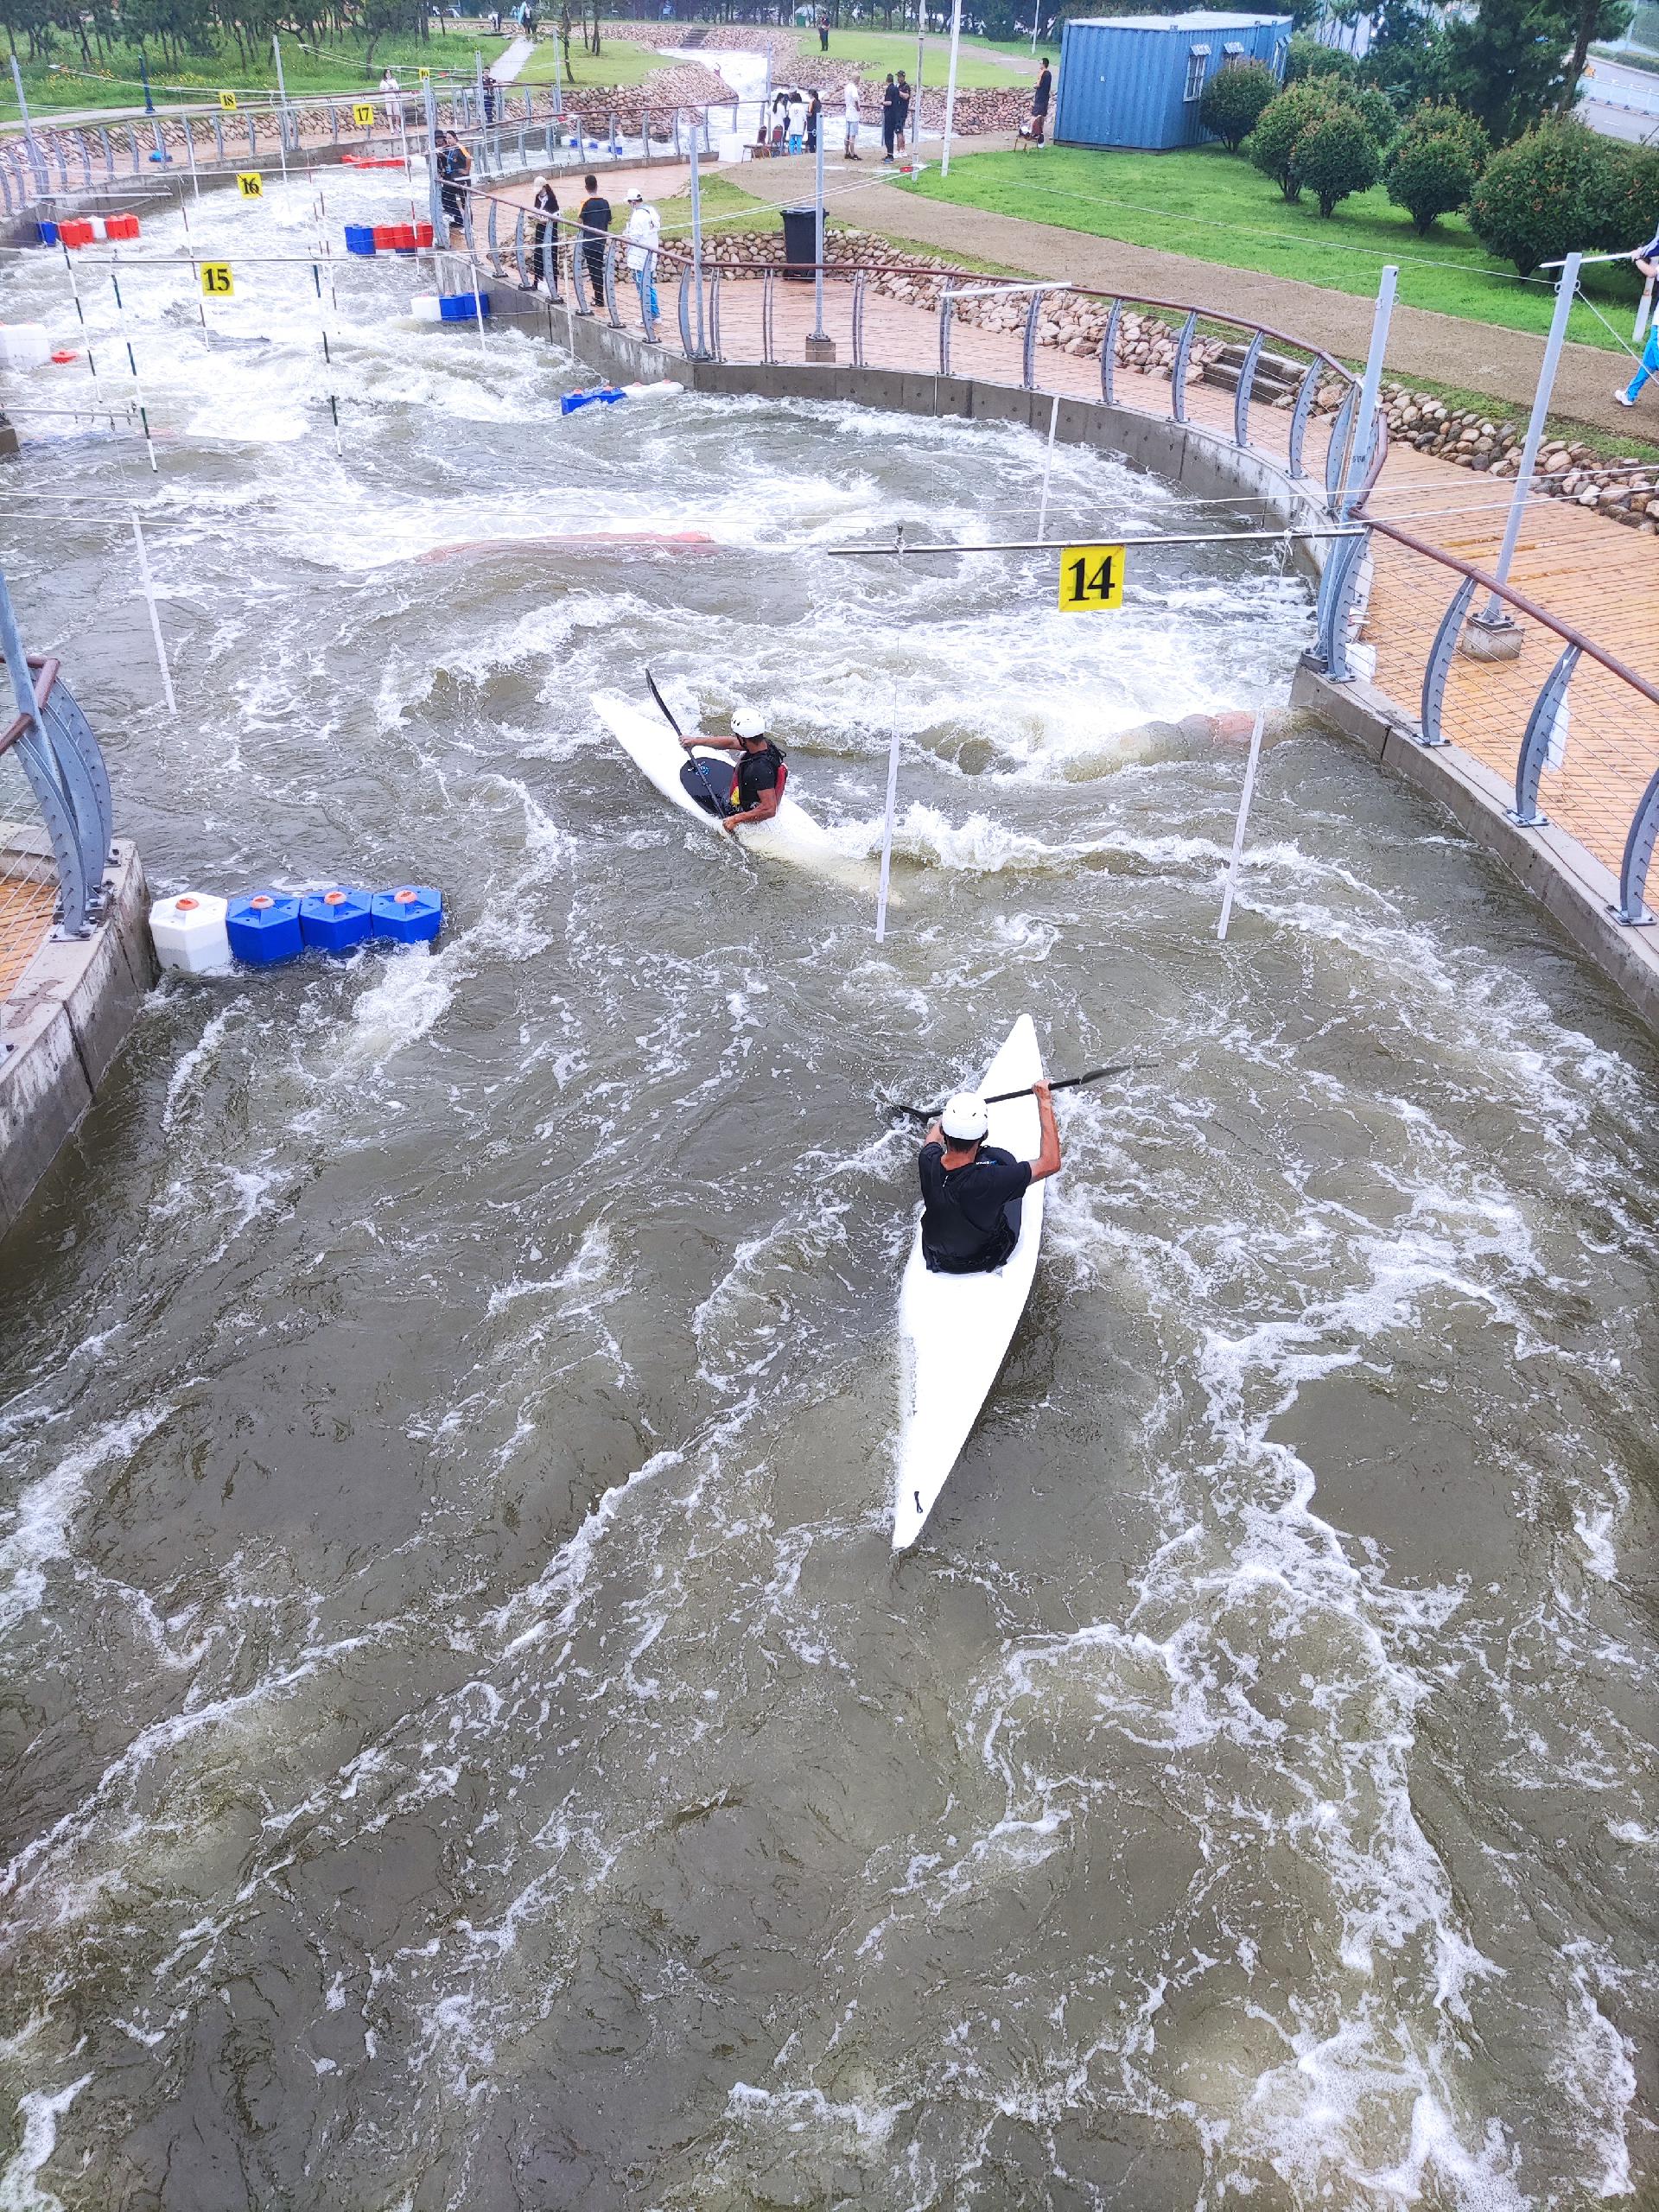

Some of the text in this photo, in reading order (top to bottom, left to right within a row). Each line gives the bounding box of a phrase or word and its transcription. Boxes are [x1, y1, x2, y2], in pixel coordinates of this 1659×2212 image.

[222, 94, 234, 106] 18
[356, 107, 369, 121] 17
[241, 177, 259, 194] 16
[203, 268, 231, 291] 15
[1068, 556, 1116, 601] 14
